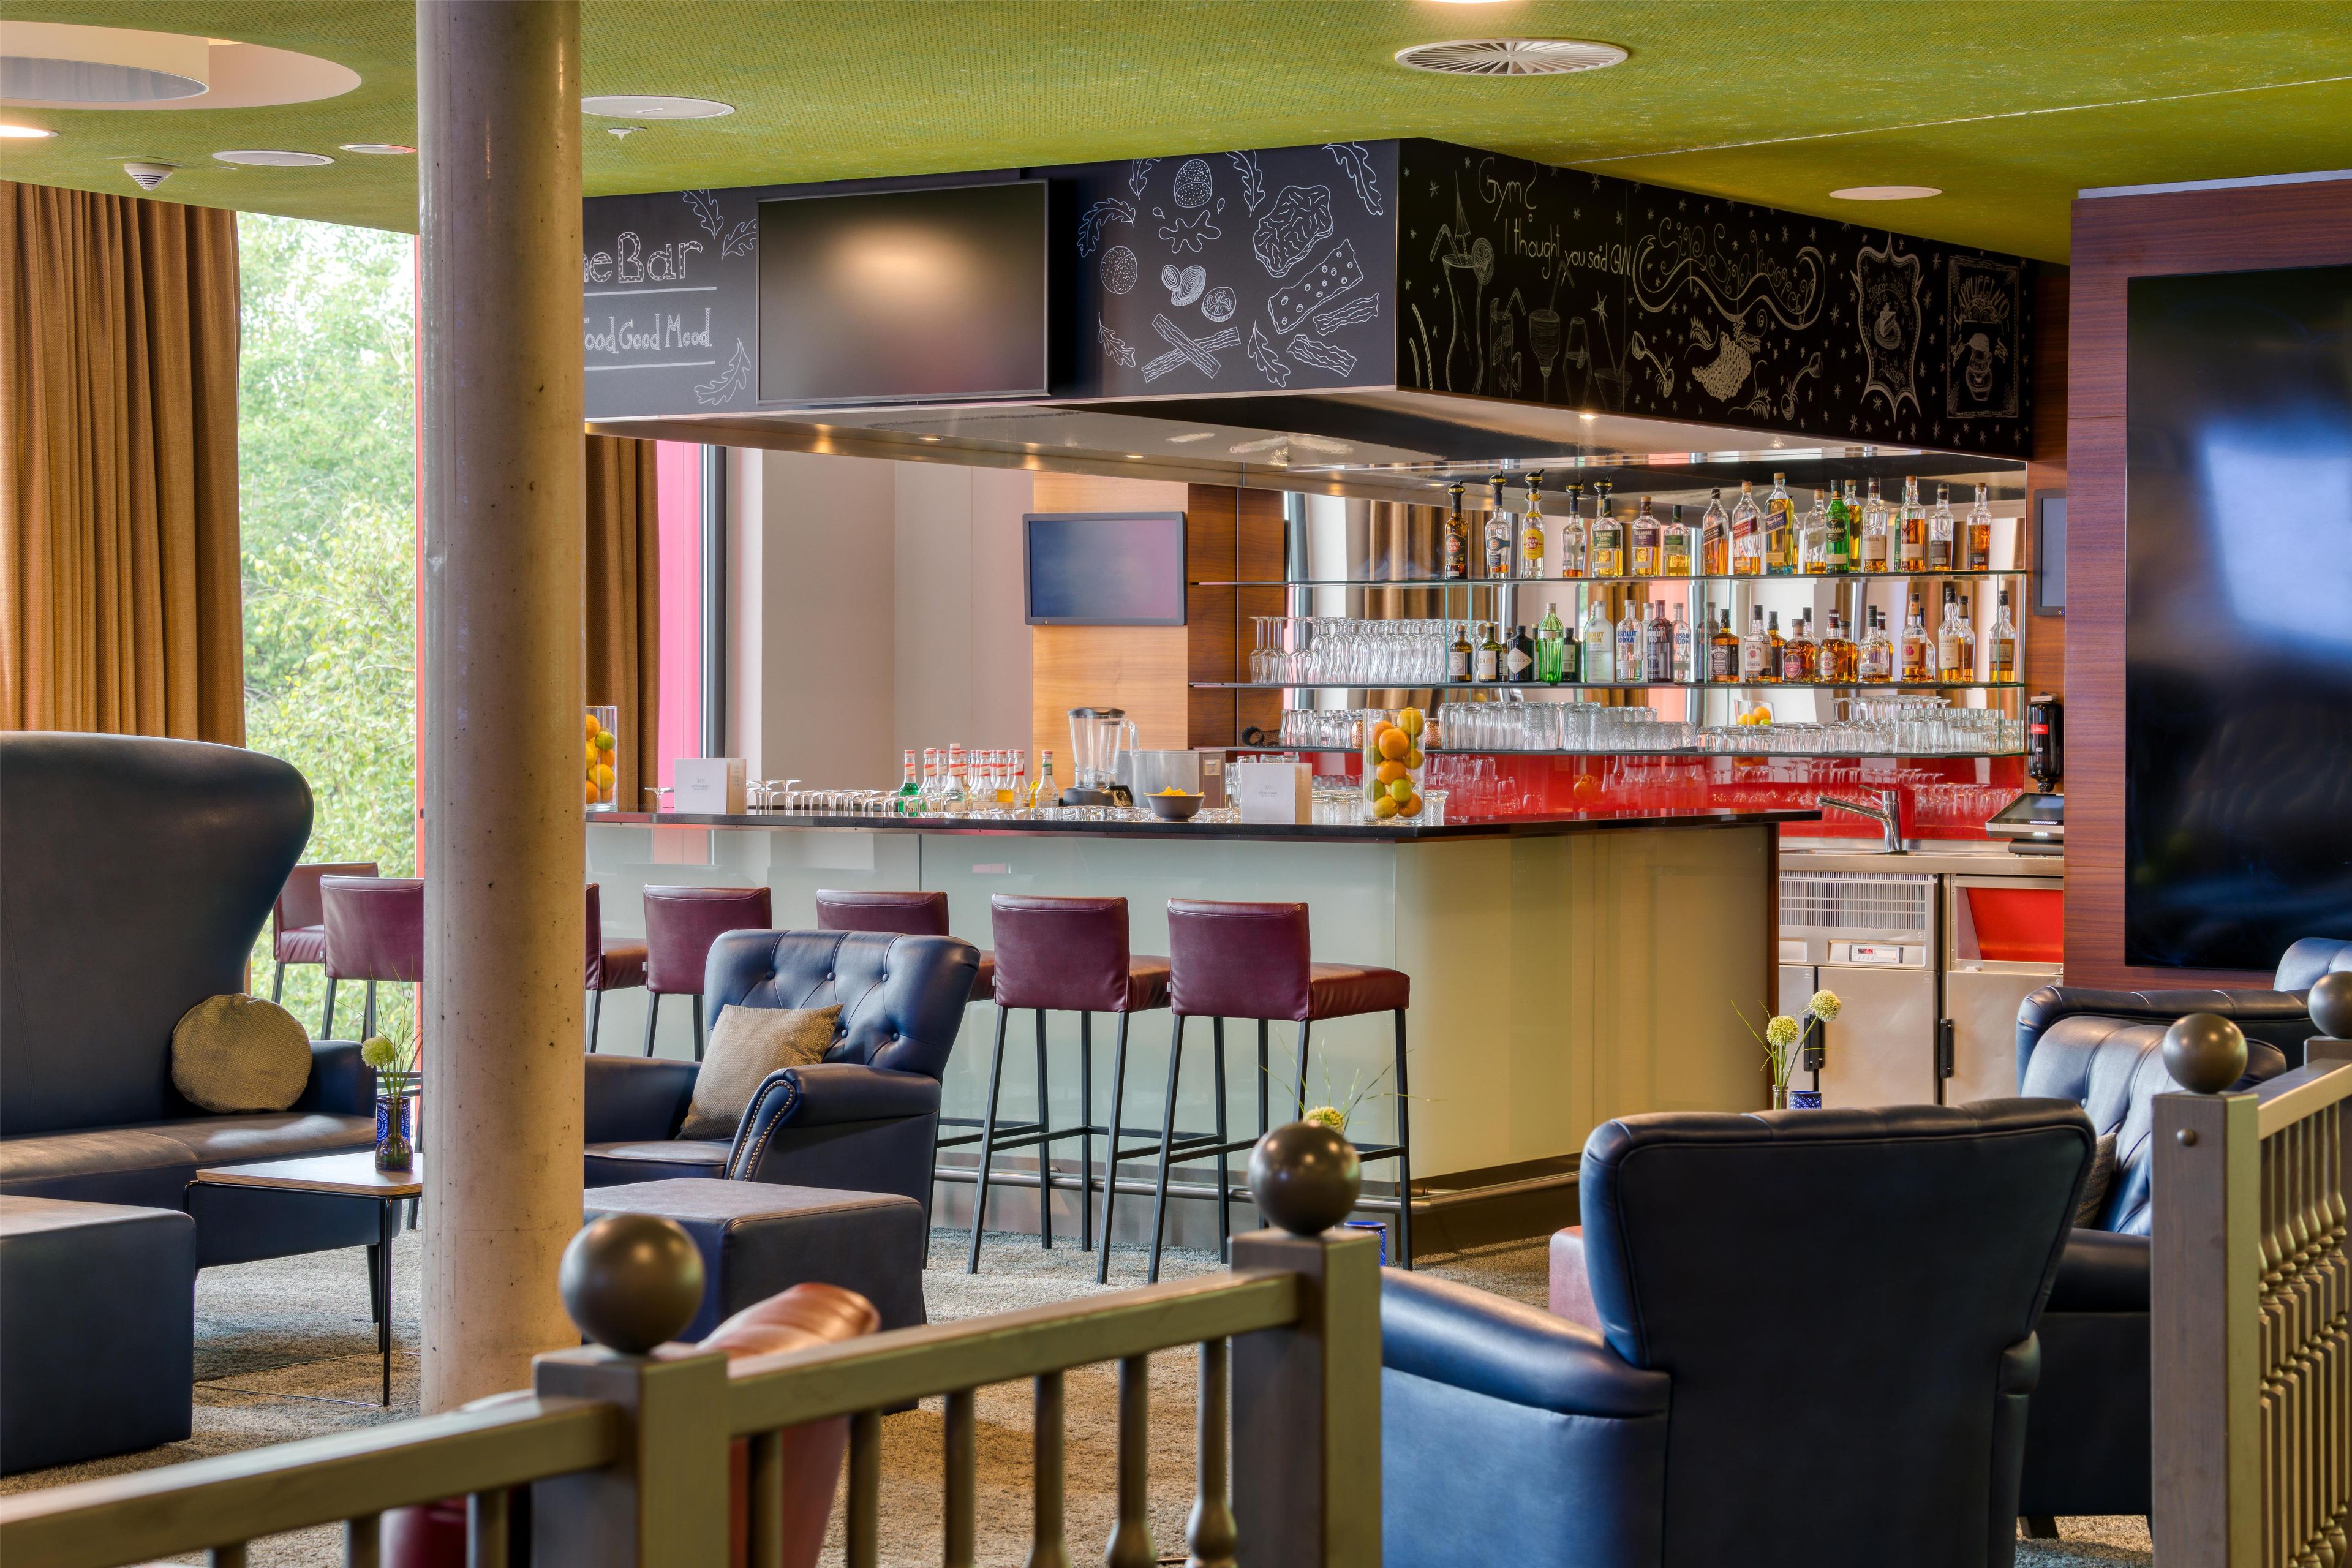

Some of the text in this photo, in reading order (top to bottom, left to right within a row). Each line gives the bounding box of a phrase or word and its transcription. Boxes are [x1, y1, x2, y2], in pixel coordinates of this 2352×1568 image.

[1477, 153, 1538, 223] Gym?
[1514, 218, 1561, 279] thought
[1564, 249, 1585, 282] you
[1587, 241, 1608, 272] said
[1954, 274, 2010, 326] CAPPUCCINO
[619, 313, 661, 351] Good
